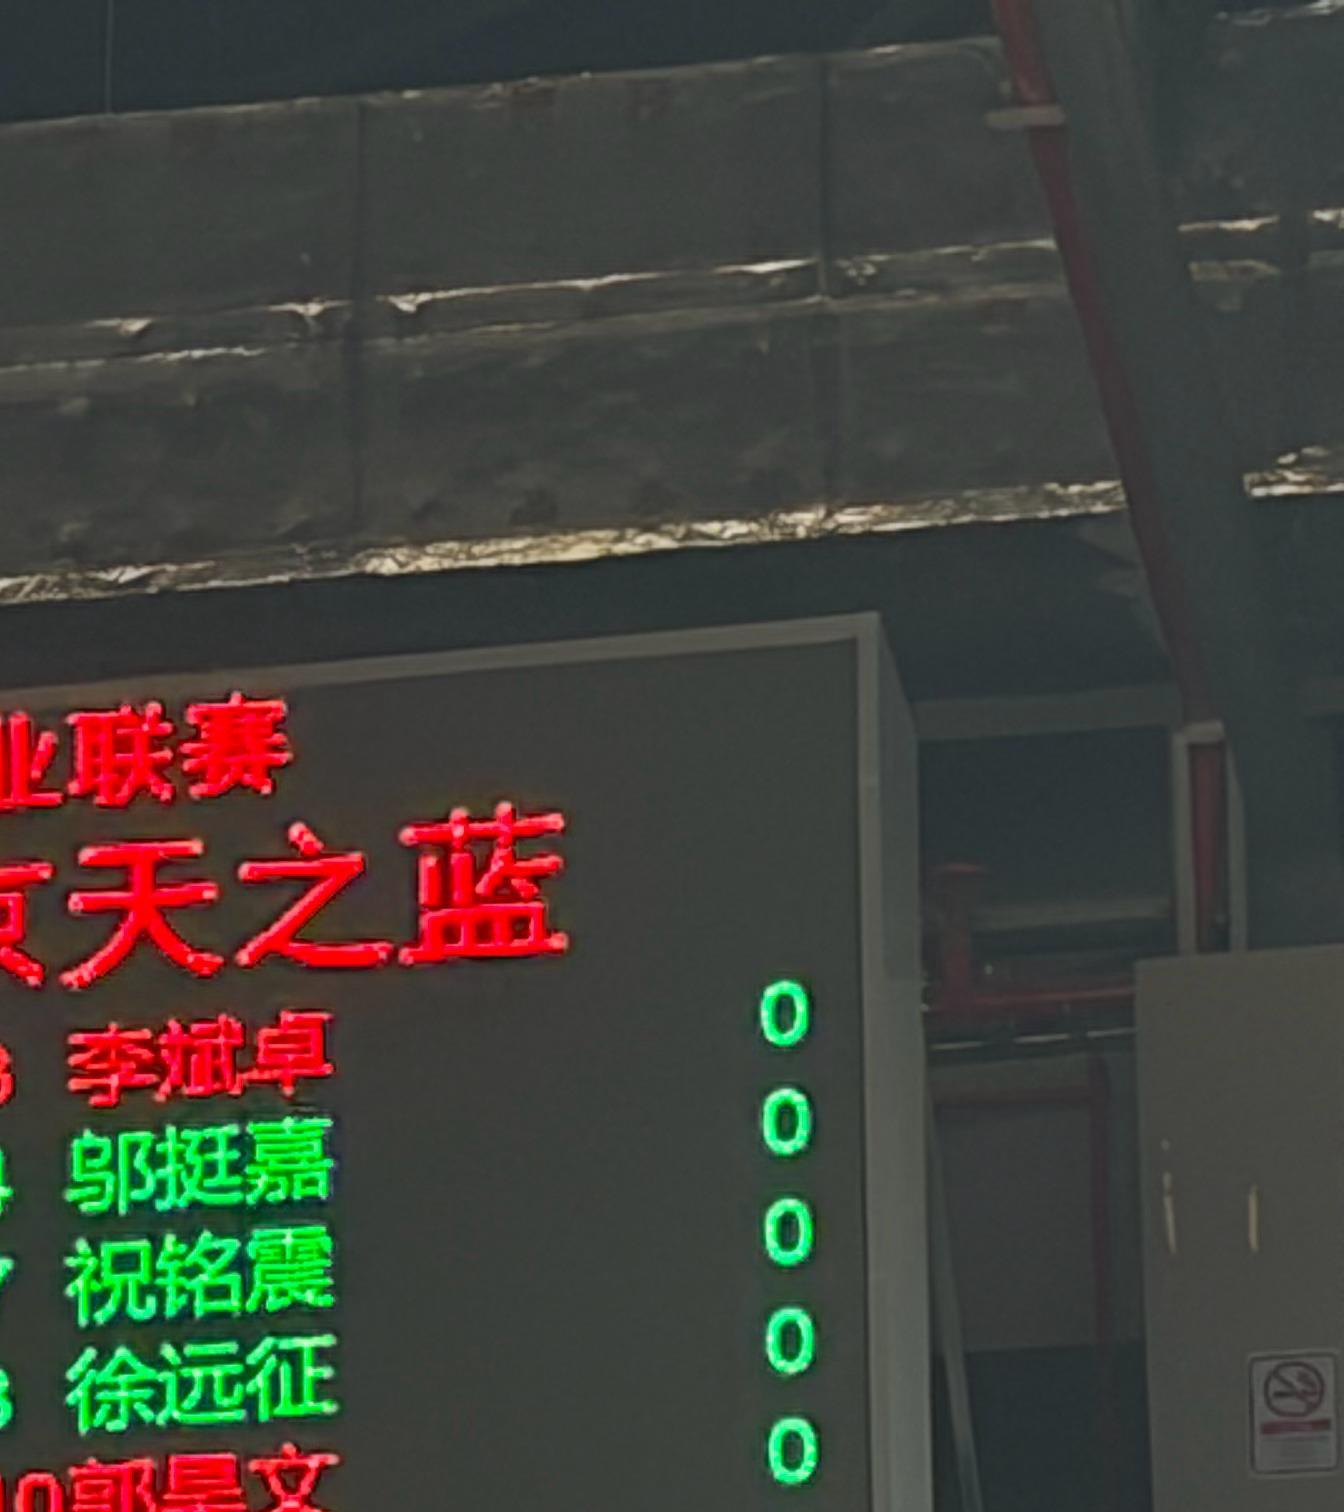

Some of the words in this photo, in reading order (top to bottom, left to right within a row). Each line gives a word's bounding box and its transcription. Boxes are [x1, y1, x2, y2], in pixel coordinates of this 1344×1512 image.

[760, 980, 808, 1046] 0
[64, 1116, 334, 1216] 邬挺嘉
[761, 1088, 811, 1156] 0
[64, 1224, 335, 1327] 祝铭震
[764, 1198, 813, 1266] 0
[65, 1334, 338, 1436] 徐远征
[765, 1307, 814, 1375] 0
[768, 1417, 817, 1485] 0
